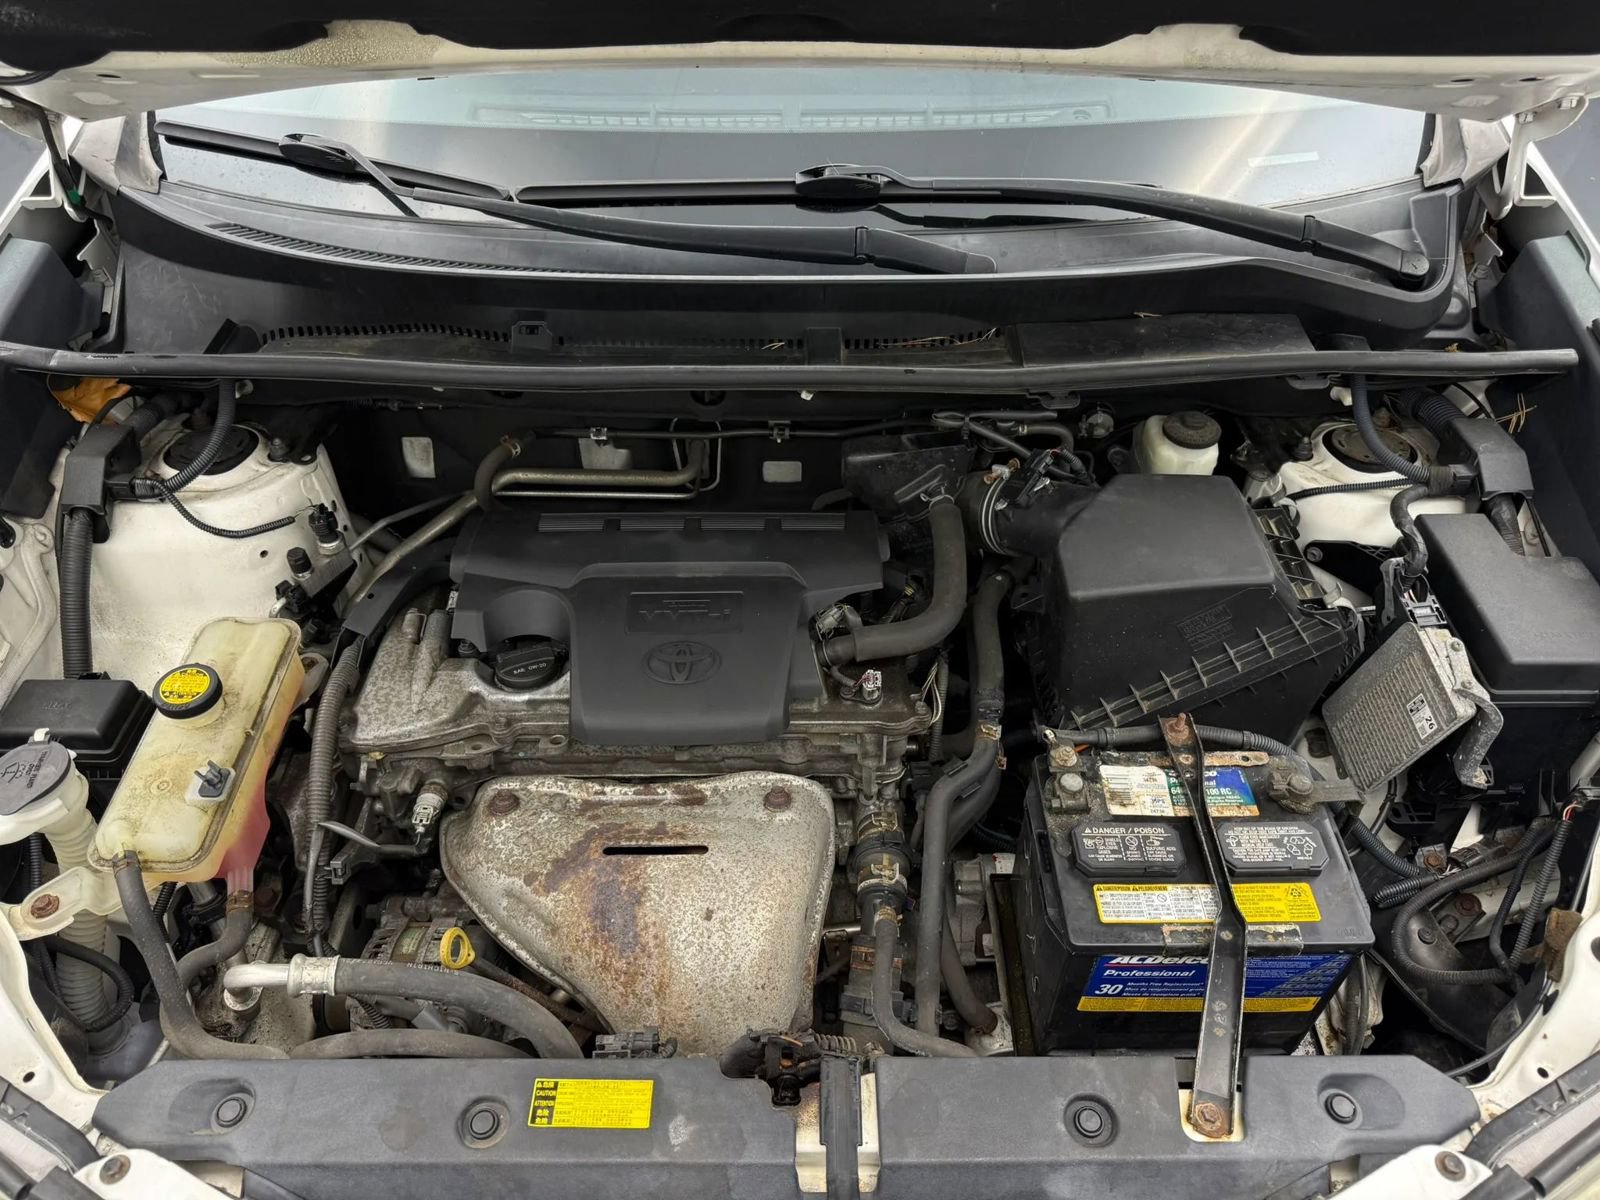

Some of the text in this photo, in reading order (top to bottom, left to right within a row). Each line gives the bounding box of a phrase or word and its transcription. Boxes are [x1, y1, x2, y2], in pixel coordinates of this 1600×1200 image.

[513, 662, 547, 676] SAE 0W-20
[1206, 788, 1219, 796] 100
[1220, 787, 1232, 795] RC
[1094, 984, 1123, 995] 30
